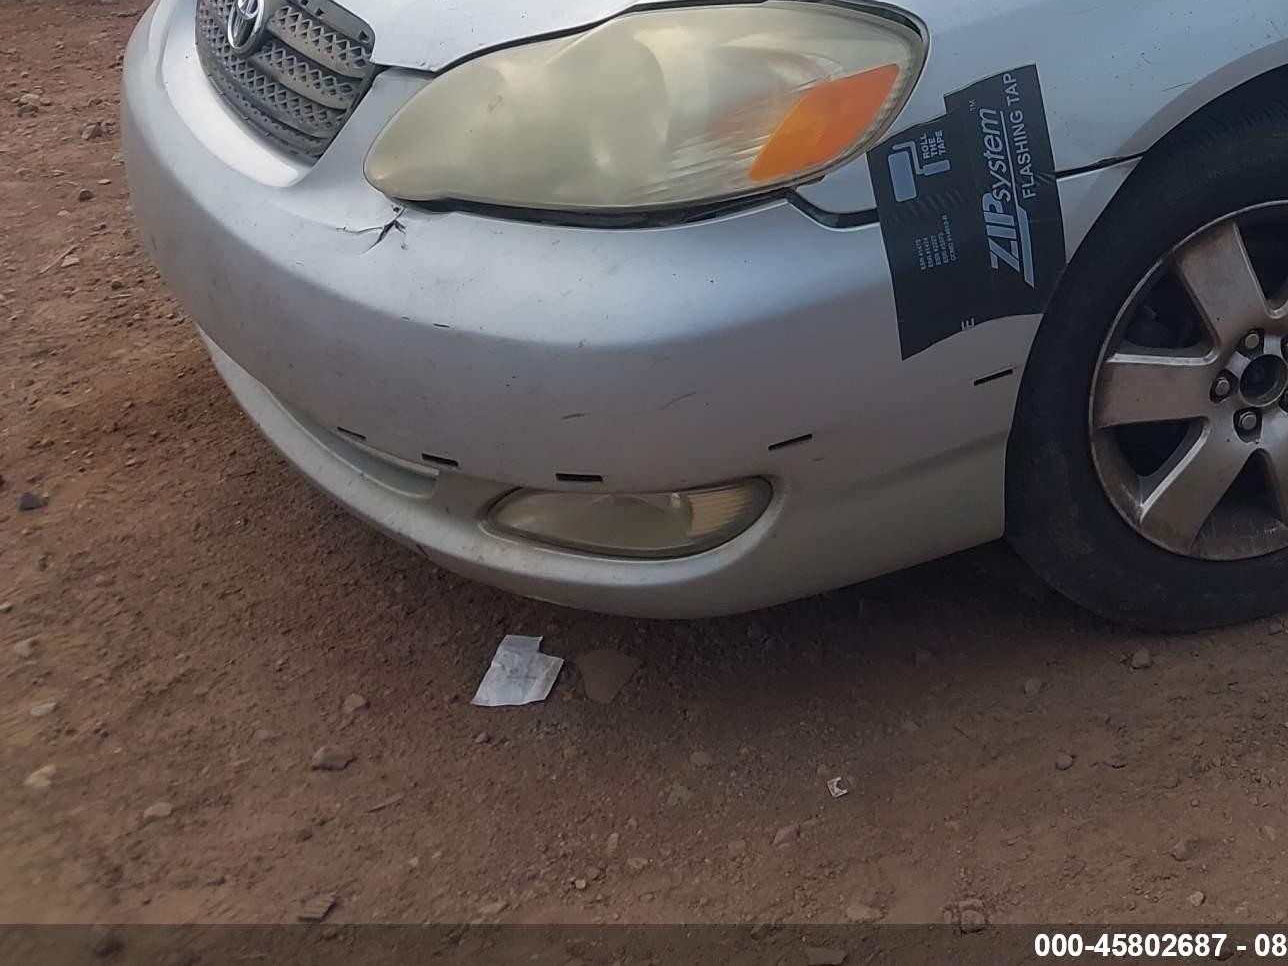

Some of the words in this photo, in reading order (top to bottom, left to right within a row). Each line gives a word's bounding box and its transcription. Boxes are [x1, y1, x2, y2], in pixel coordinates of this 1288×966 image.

[920, 133, 931, 159] ROLL
[928, 137, 938, 157] THE
[935, 130, 946, 155] TAPE
[1010, 110, 1036, 199] FLASHING
